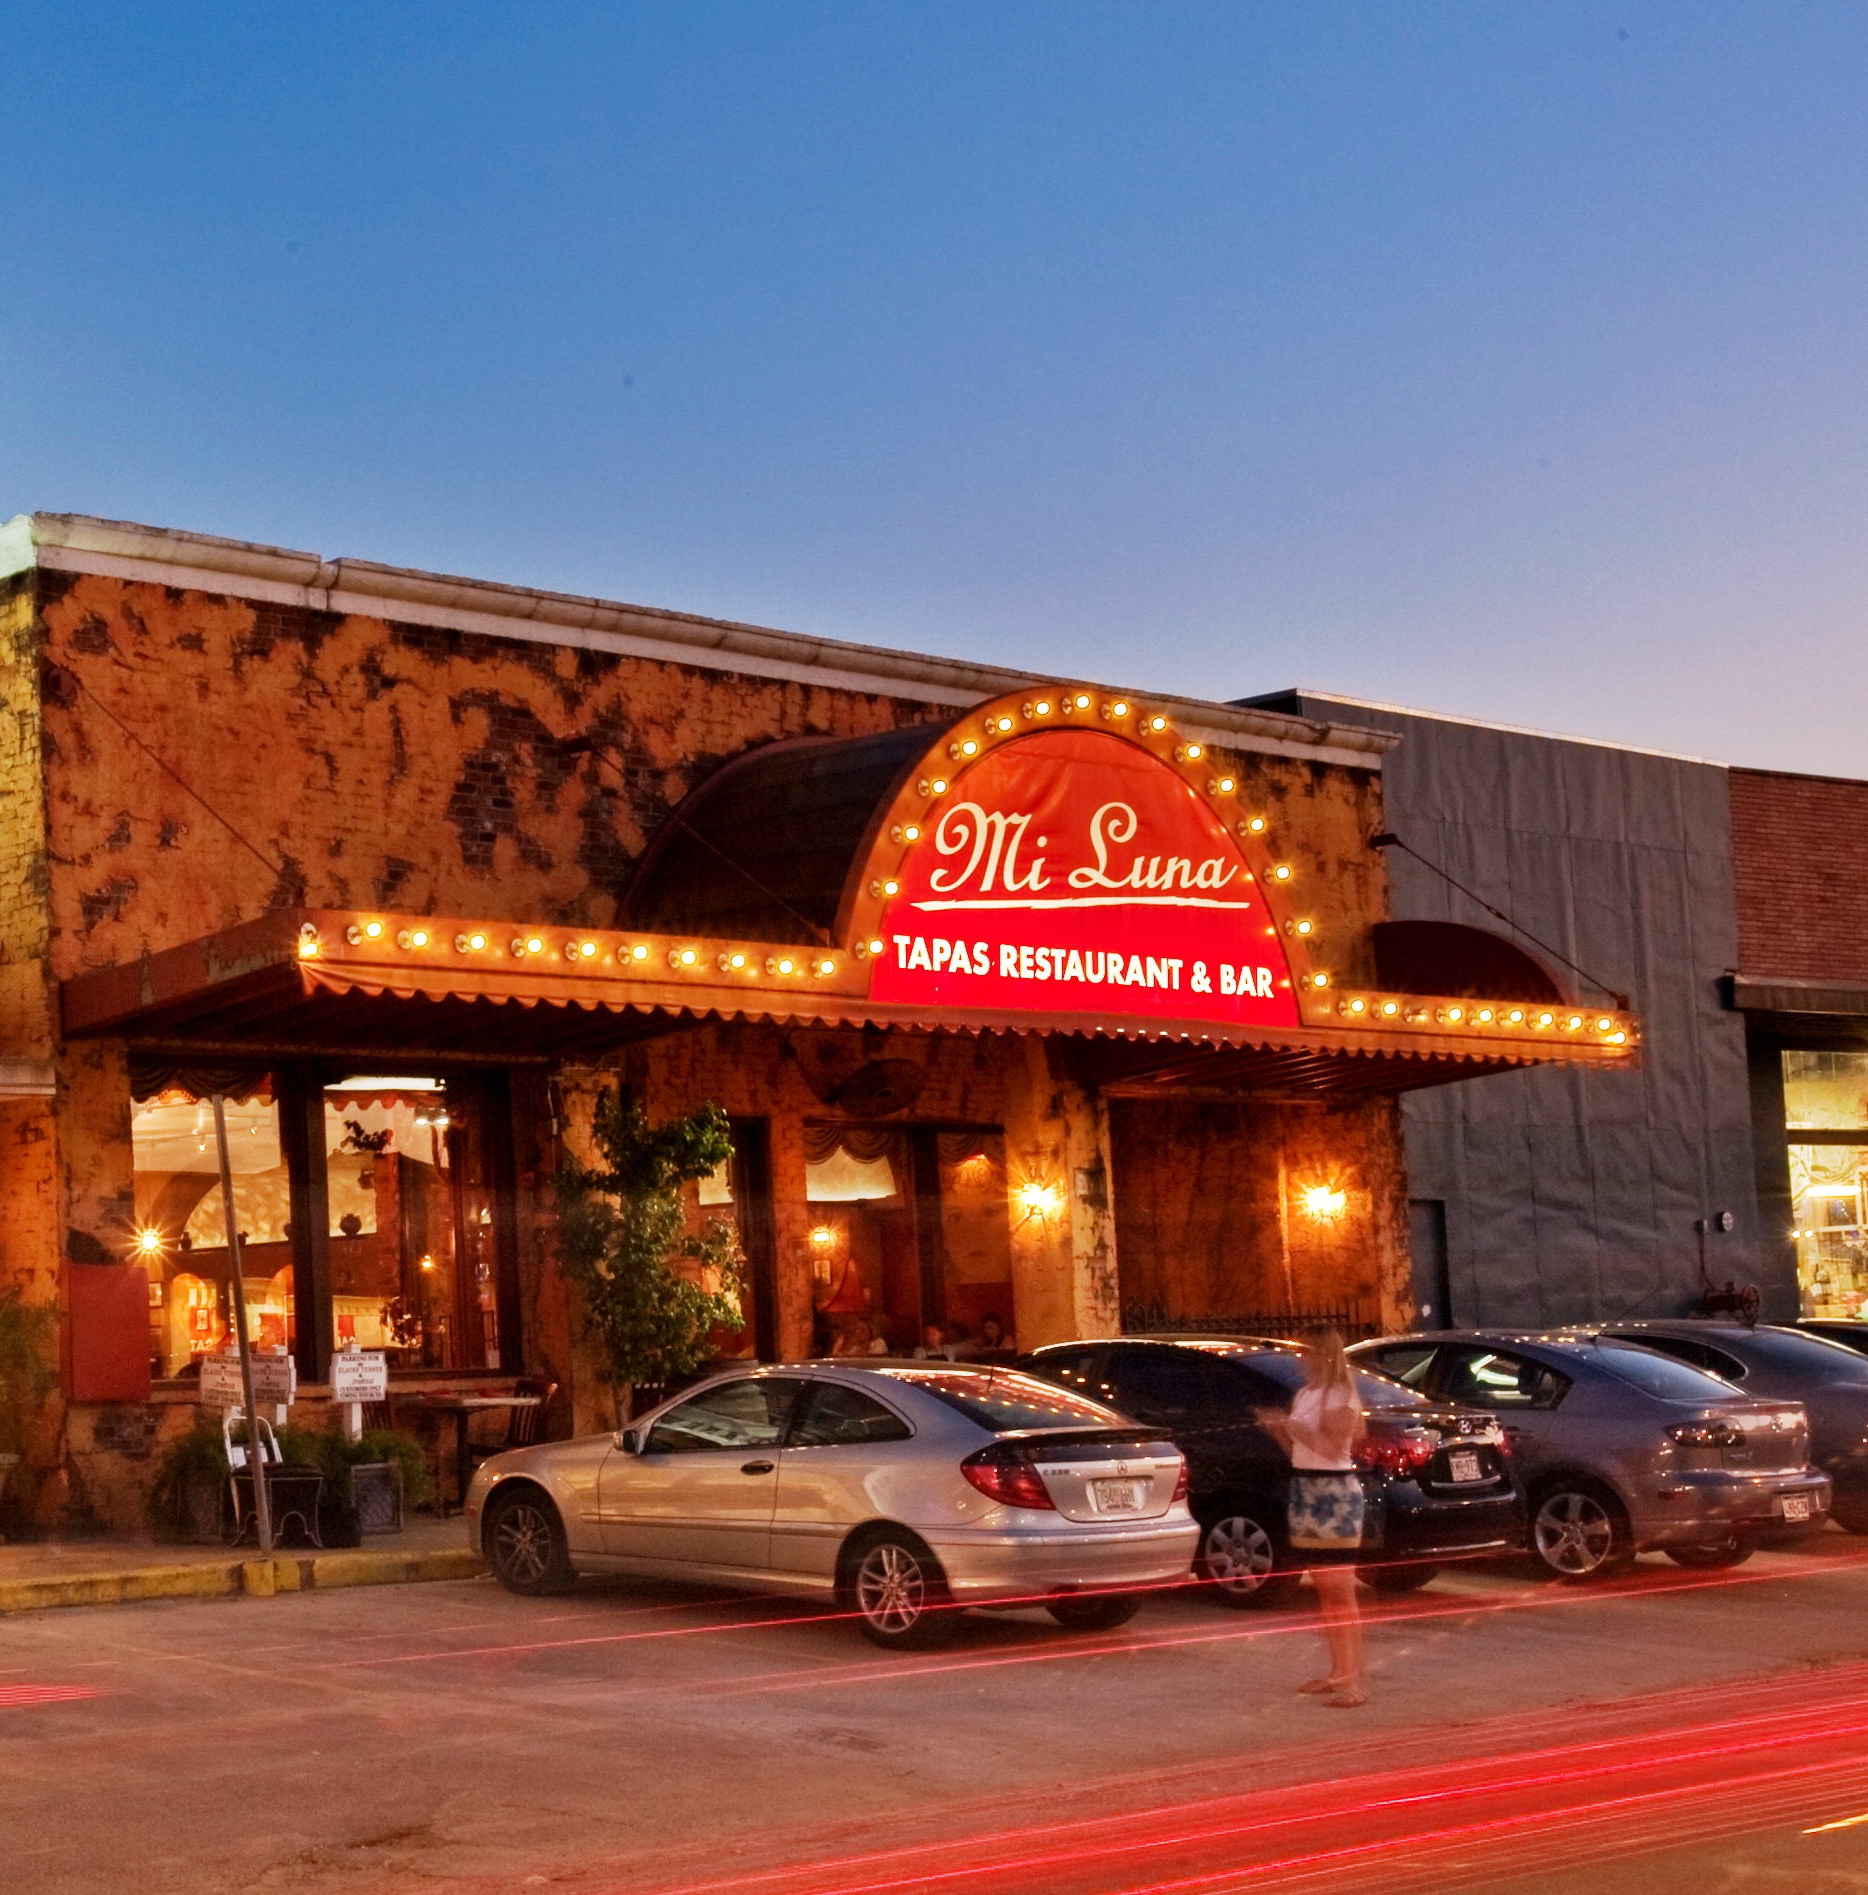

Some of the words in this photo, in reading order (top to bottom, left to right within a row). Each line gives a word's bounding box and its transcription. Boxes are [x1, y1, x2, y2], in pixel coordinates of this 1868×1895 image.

[930, 802, 1051, 892] Mi
[1068, 802, 1238, 890] Luna
[893, 935, 989, 975] TAPAS
[999, 944, 1183, 989] RESTAURANT
[1191, 961, 1212, 994] &
[1220, 964, 1274, 998] BAR
